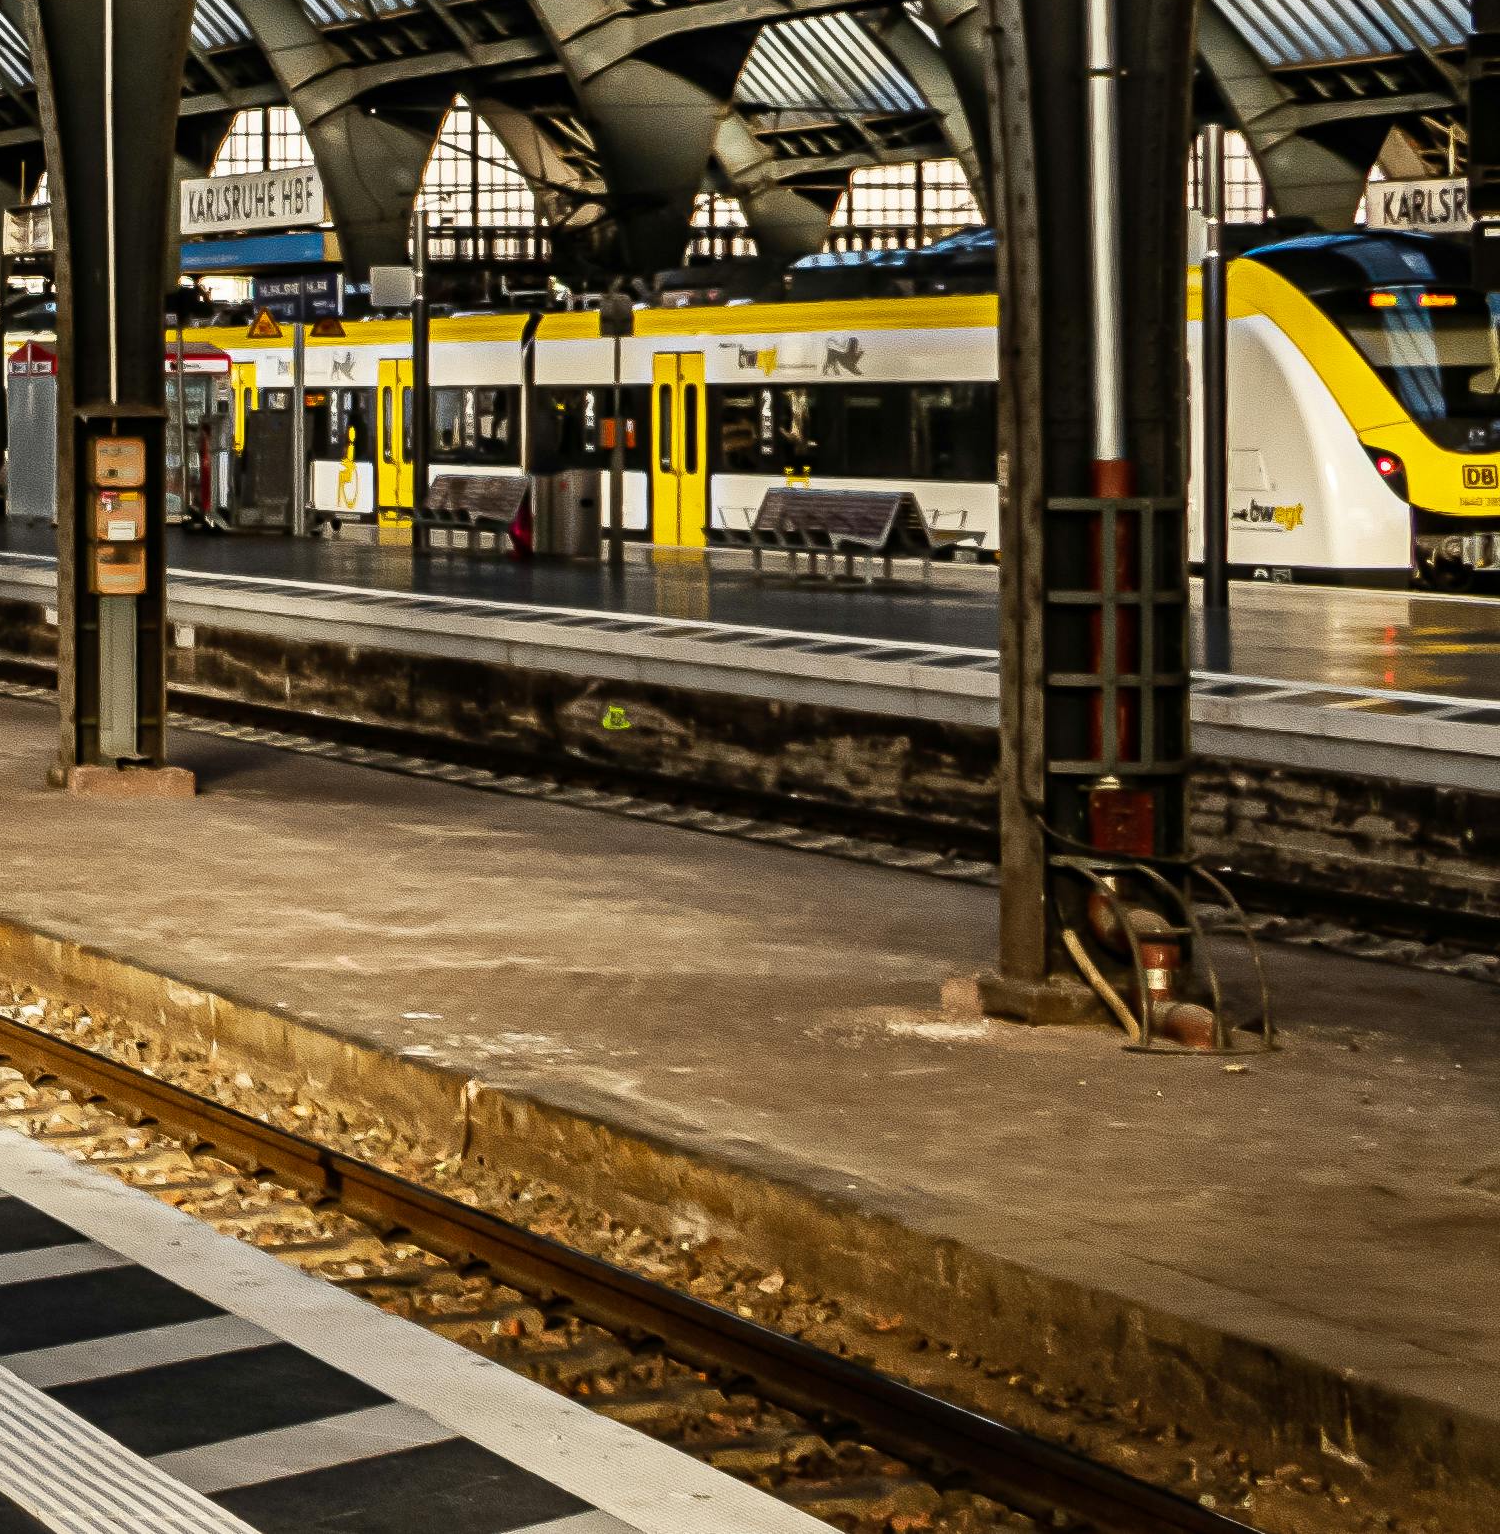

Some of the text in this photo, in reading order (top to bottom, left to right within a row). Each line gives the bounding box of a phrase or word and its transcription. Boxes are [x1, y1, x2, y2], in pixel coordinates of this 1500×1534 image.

[189, 174, 314, 223] KARLSRUHE HBF
[1383, 187, 1468, 226] KARLSR
[1467, 468, 1495, 485] DB
